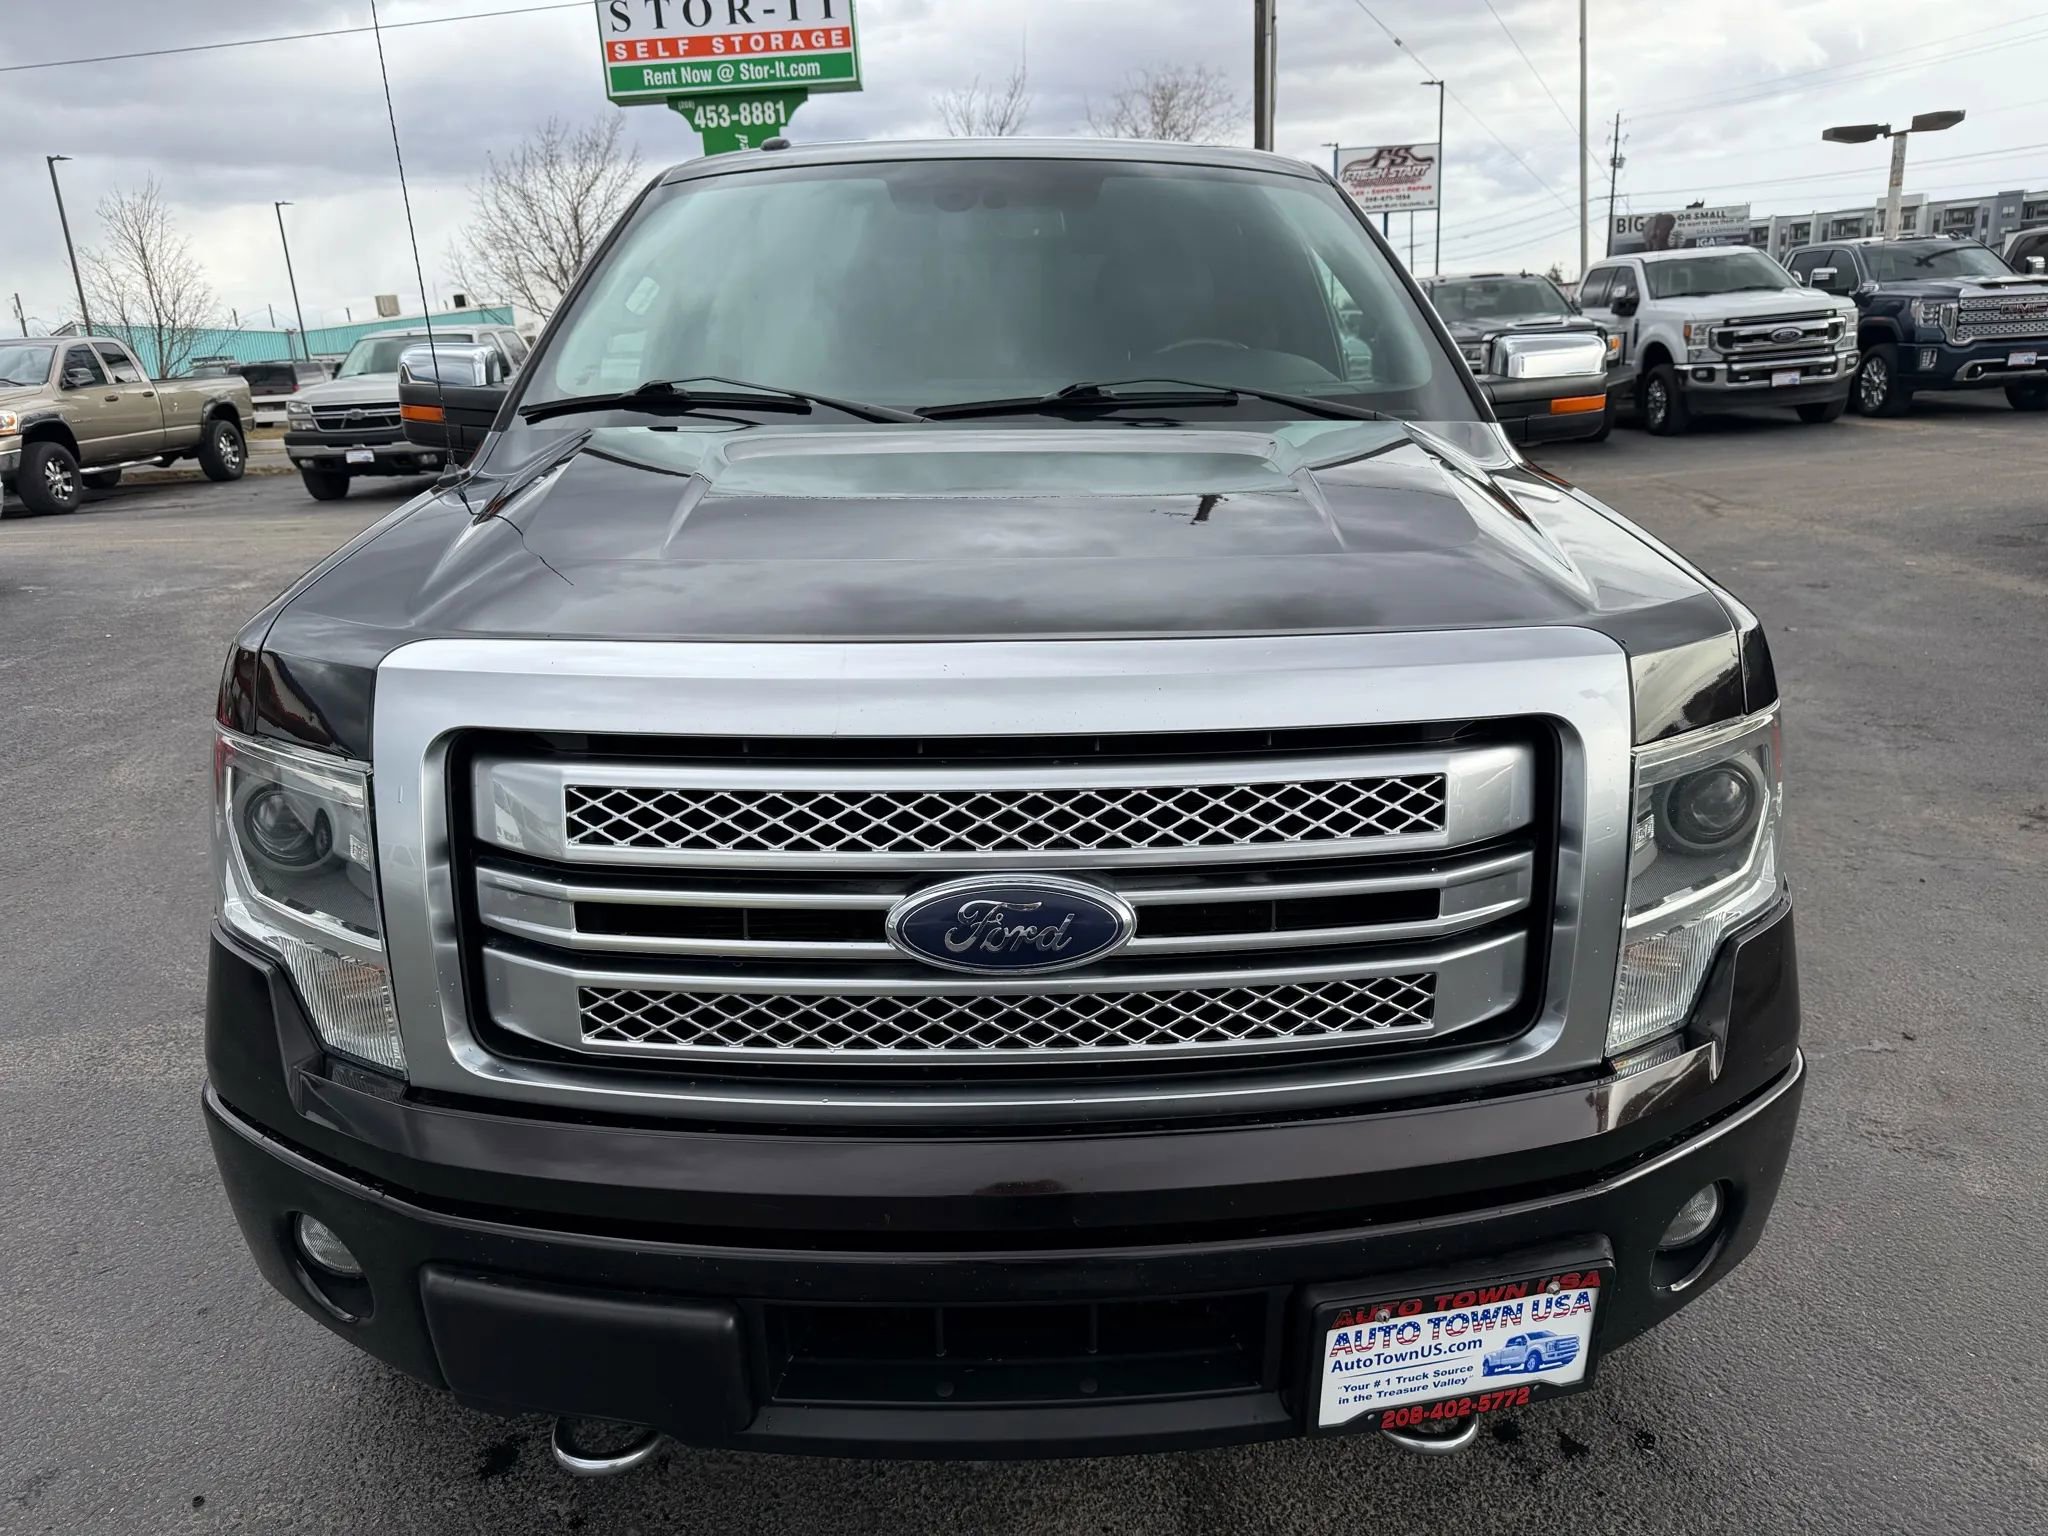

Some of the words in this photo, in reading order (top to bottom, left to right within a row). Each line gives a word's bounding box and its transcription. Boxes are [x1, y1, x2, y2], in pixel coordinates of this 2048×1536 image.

[615, 39, 690, 60] SELF
[712, 30, 844, 54] STORAGE
[643, 68, 678, 86] Rent
[681, 66, 712, 84] Now
[717, 63, 735, 83] @
[740, 61, 821, 80] Stor-It.com
[694, 100, 786, 128] 453-8881
[1388, 163, 1431, 178] START
[1372, 187, 1400, 195] SERVICE
[1616, 216, 1645, 234] BIG
[1694, 211, 1726, 219] SMALL
[944, 899, 1075, 952] Ford
[1332, 1299, 1423, 1329] AUTO
[1434, 1282, 1528, 1310] TOWN
[1537, 1270, 1600, 1294] USA
[1329, 1321, 1421, 1358] AUTO
[1427, 1303, 1523, 1340] TOWN
[1531, 1291, 1592, 1323] USA
[1331, 1338, 1482, 1373] AutoTownUS.com
[1374, 1379, 1381, 1388] #
[1395, 1372, 1429, 1385] Truck
[1433, 1364, 1474, 1378] Source
[1338, 1397, 1349, 1405] in
[1353, 1393, 1372, 1403] the
[1376, 1384, 1429, 1399] Treasure
[1381, 1386, 1530, 1429] 208-402-5772
